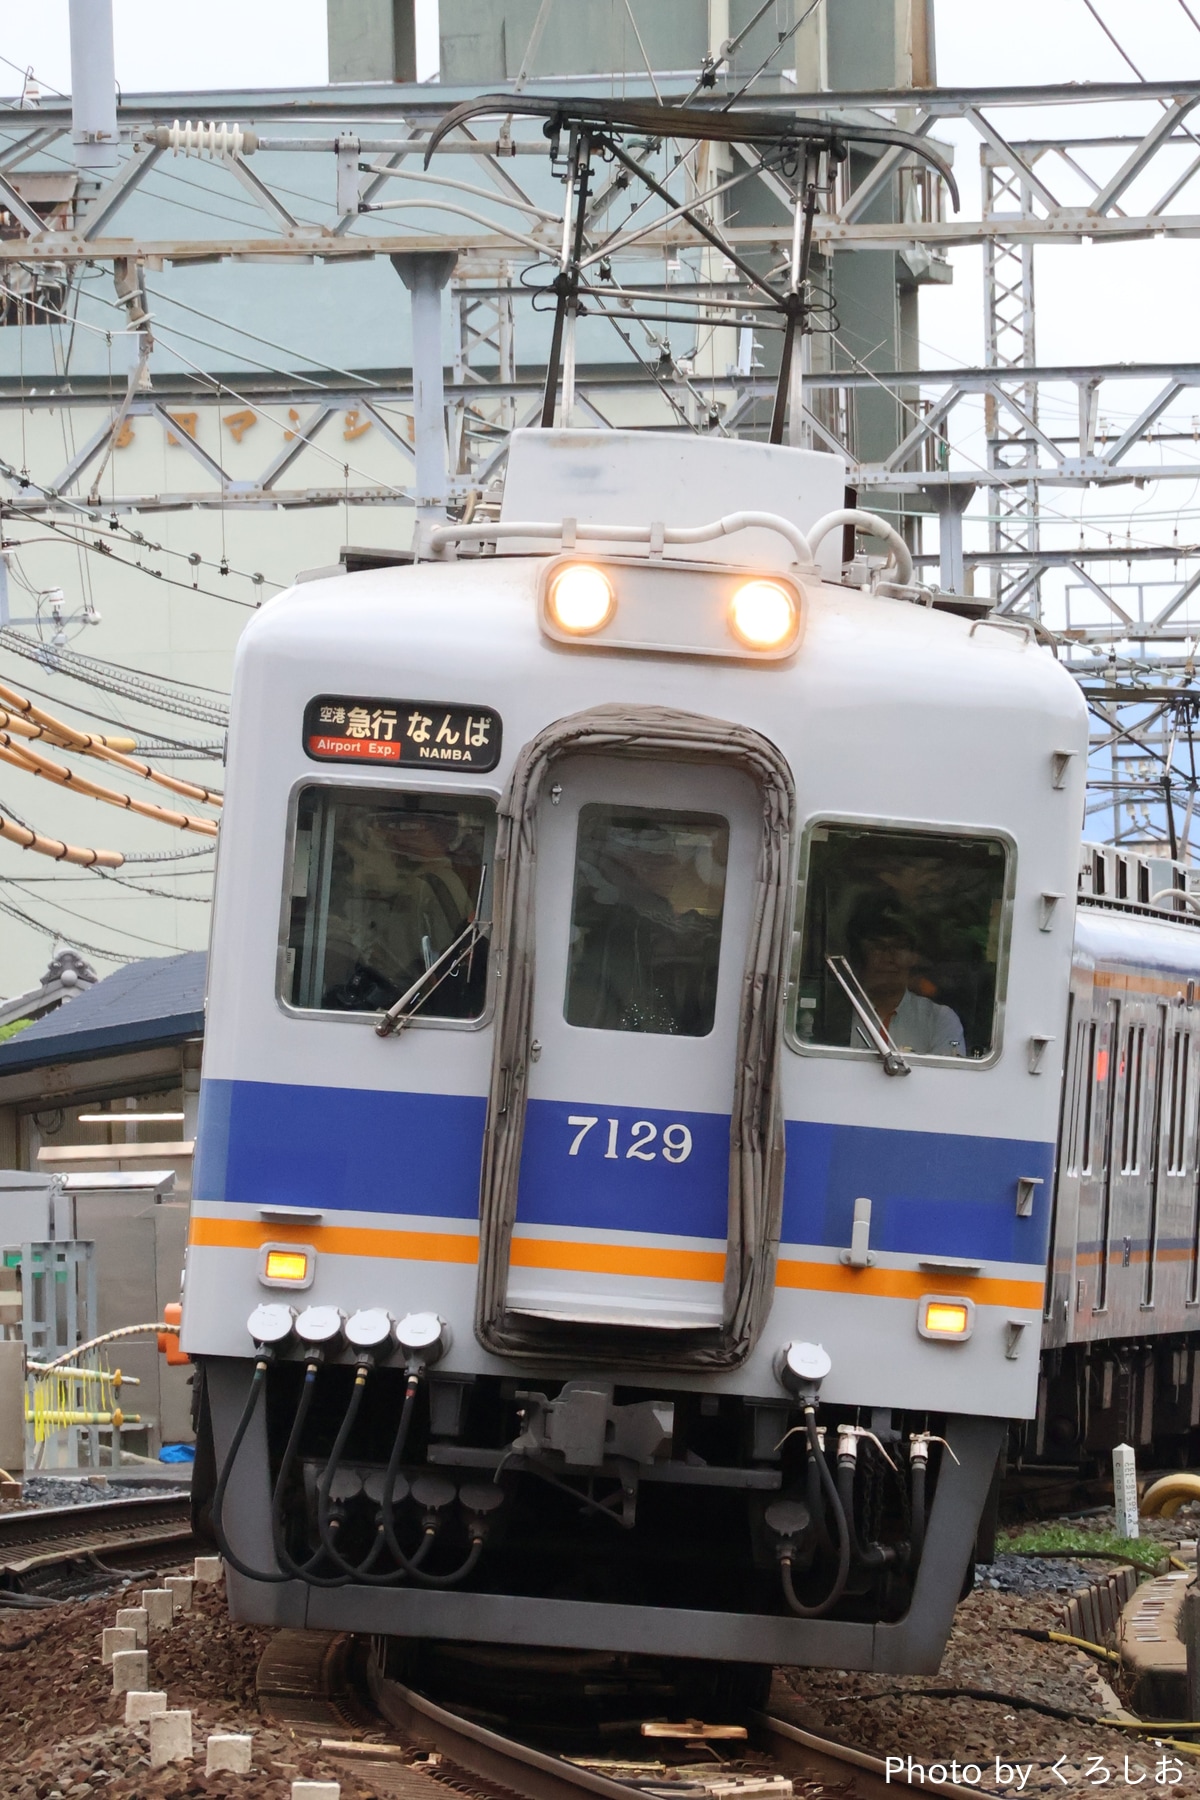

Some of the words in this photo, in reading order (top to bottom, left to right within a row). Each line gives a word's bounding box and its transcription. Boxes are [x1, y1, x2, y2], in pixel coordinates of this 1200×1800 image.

[319, 706, 398, 741] 空港急行
[406, 711, 492, 747] なんば
[317, 739, 361, 753] Airport
[368, 743, 396, 756] Exp.
[419, 747, 473, 761] NAMBA
[567, 1115, 693, 1163] 7129
